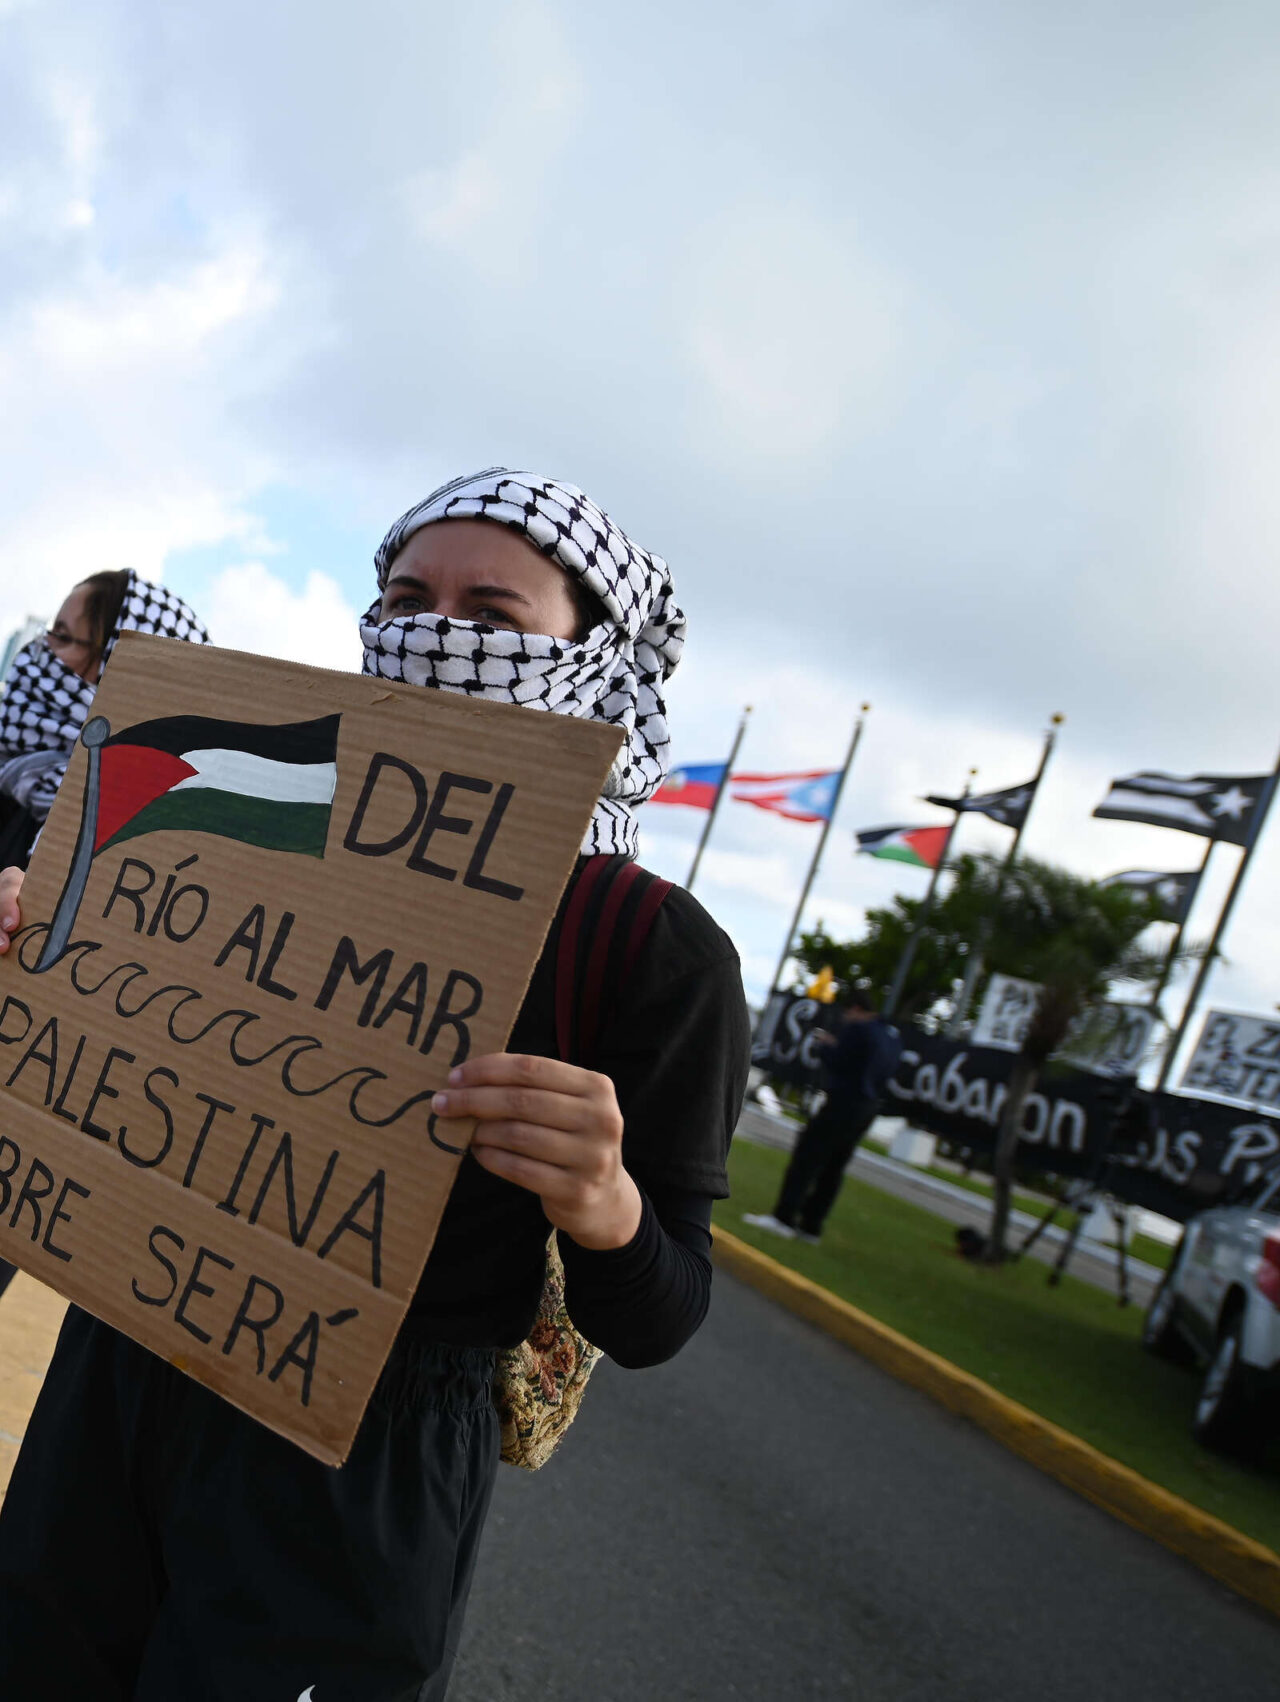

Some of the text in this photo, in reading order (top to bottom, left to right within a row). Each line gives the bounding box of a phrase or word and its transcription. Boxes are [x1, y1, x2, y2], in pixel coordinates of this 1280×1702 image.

[342, 751, 525, 902] DEL
[102, 853, 484, 1069] RÍO AL MAR
[131, 1224, 360, 1411] SERÁ
